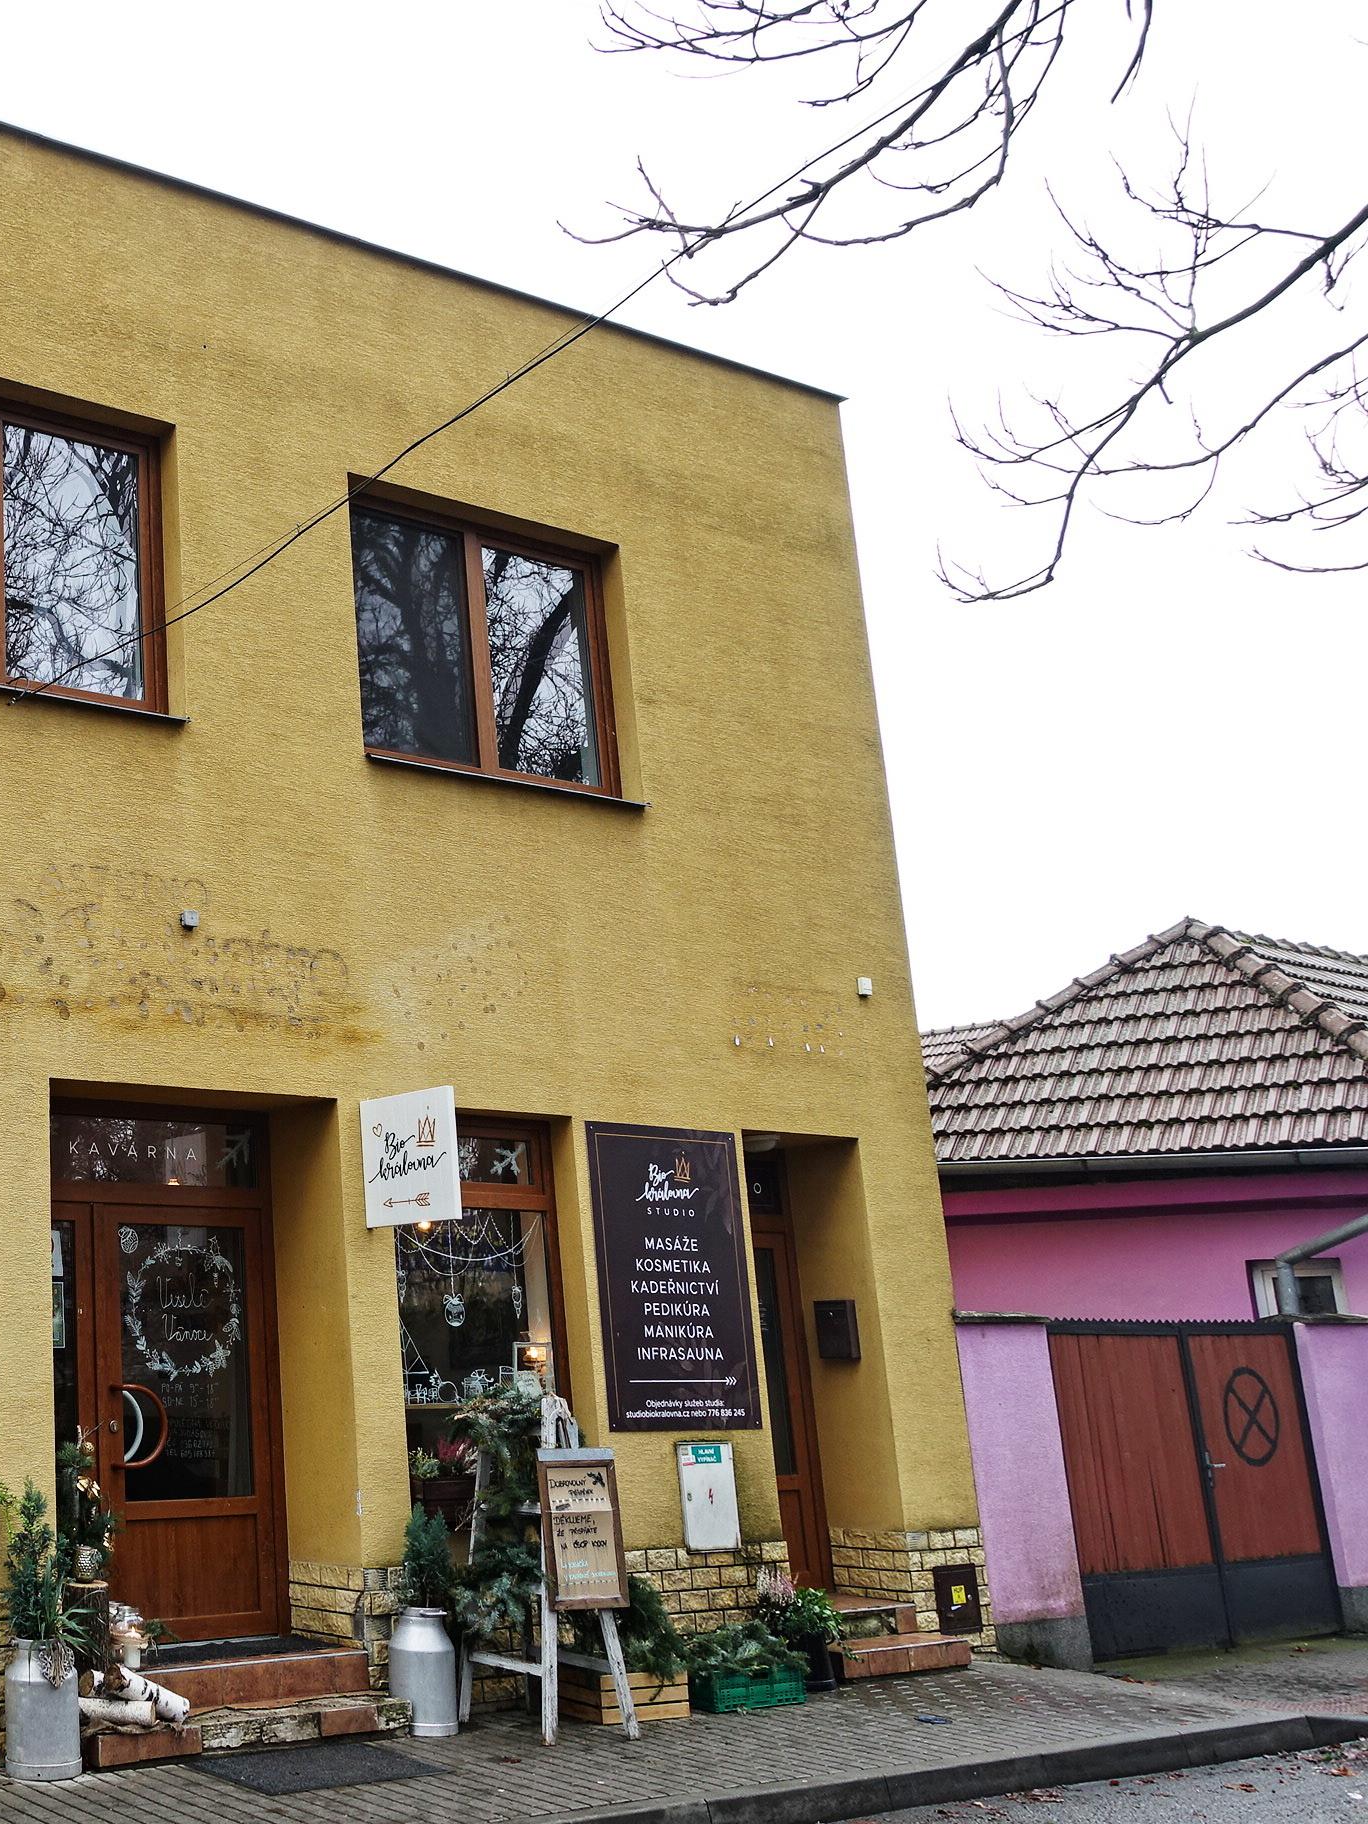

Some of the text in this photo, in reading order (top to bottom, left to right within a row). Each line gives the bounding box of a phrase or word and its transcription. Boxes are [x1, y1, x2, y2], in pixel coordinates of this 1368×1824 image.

[384, 1131, 415, 1160] Bio
[368, 1150, 447, 1184] královna
[647, 1163, 675, 1187] Bio
[635, 1181, 700, 1202] královna
[646, 1206, 696, 1217] STUDIO
[644, 1236, 699, 1252] MASÁŽE
[635, 1258, 711, 1274] KOSMETIKA
[630, 1278, 720, 1295] KADEŘNICTVÍ
[643, 1300, 711, 1317] PEDIKÚRA
[644, 1322, 714, 1338] MANIKÚRA
[637, 1347, 724, 1361] INFRASAUNA
[645, 1400, 683, 1410] Objednávky
[684, 1399, 704, 1408] služeb
[626, 1408, 746, 1419] studiobiokralovna.cz nebo 776 836 245
